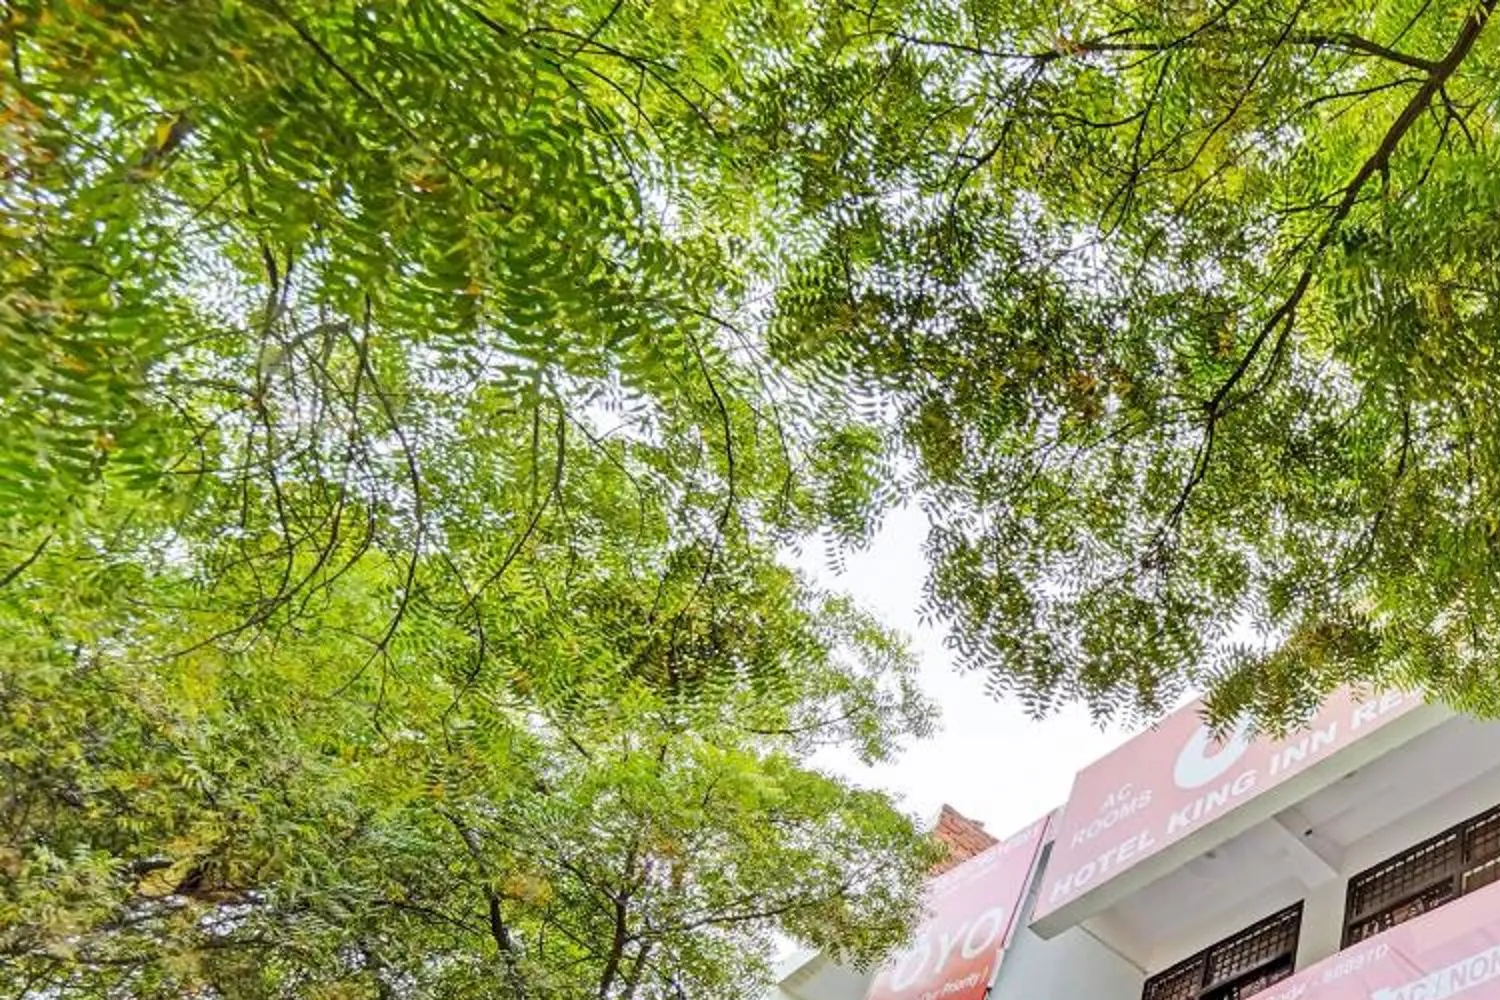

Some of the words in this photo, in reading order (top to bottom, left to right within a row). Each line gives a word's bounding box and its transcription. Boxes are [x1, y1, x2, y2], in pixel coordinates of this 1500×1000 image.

[1052, 830, 1156, 900] HOTEL
[1166, 769, 1258, 835] KING
[1268, 721, 1339, 777] INN
[1071, 789, 1153, 848] ROOMS
[1101, 782, 1132, 809] AC
